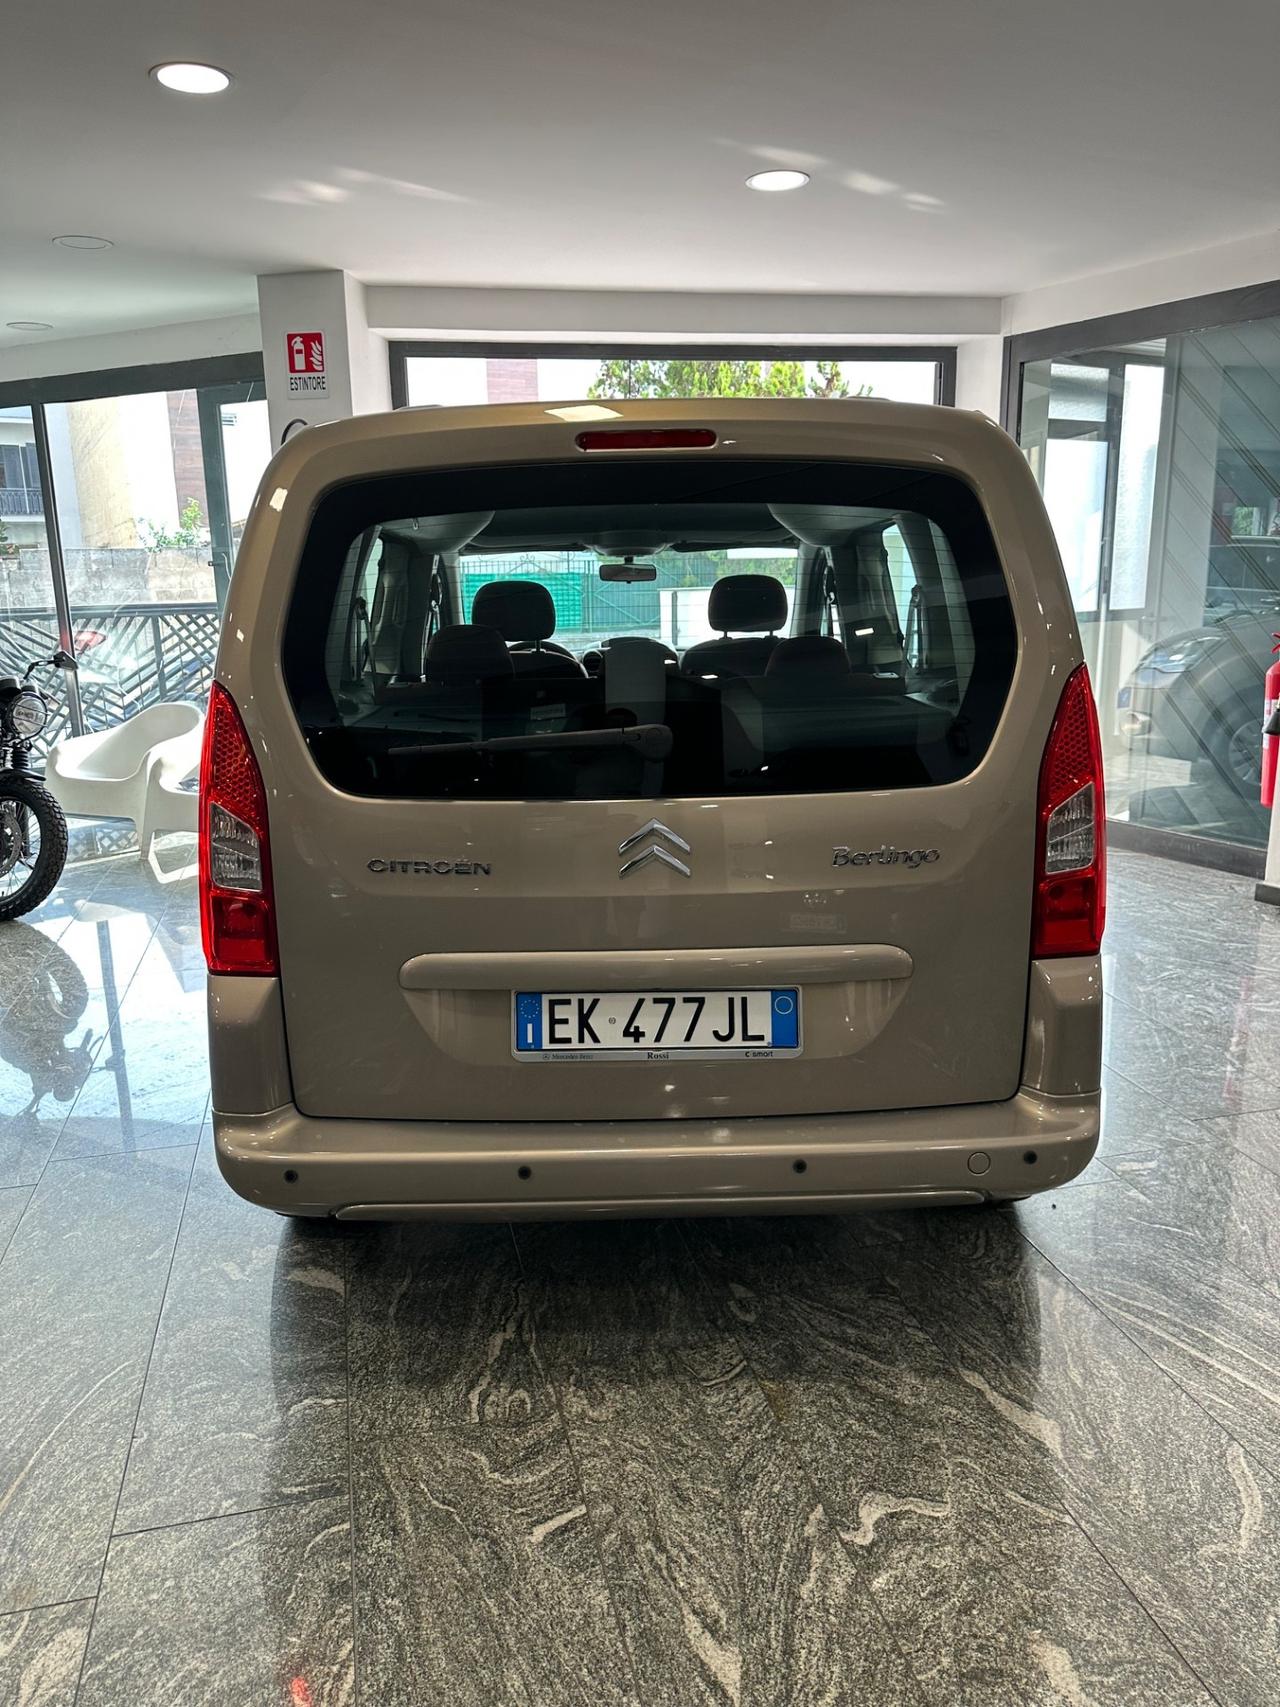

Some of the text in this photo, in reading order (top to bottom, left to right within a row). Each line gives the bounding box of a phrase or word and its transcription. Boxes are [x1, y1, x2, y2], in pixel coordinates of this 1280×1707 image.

[290, 376, 326, 391] ESTINTORE
[832, 845, 940, 869] Berlingo
[548, 998, 601, 1044] EK
[647, 1051, 670, 1060] Rossi
[752, 1050, 773, 1058] smart
